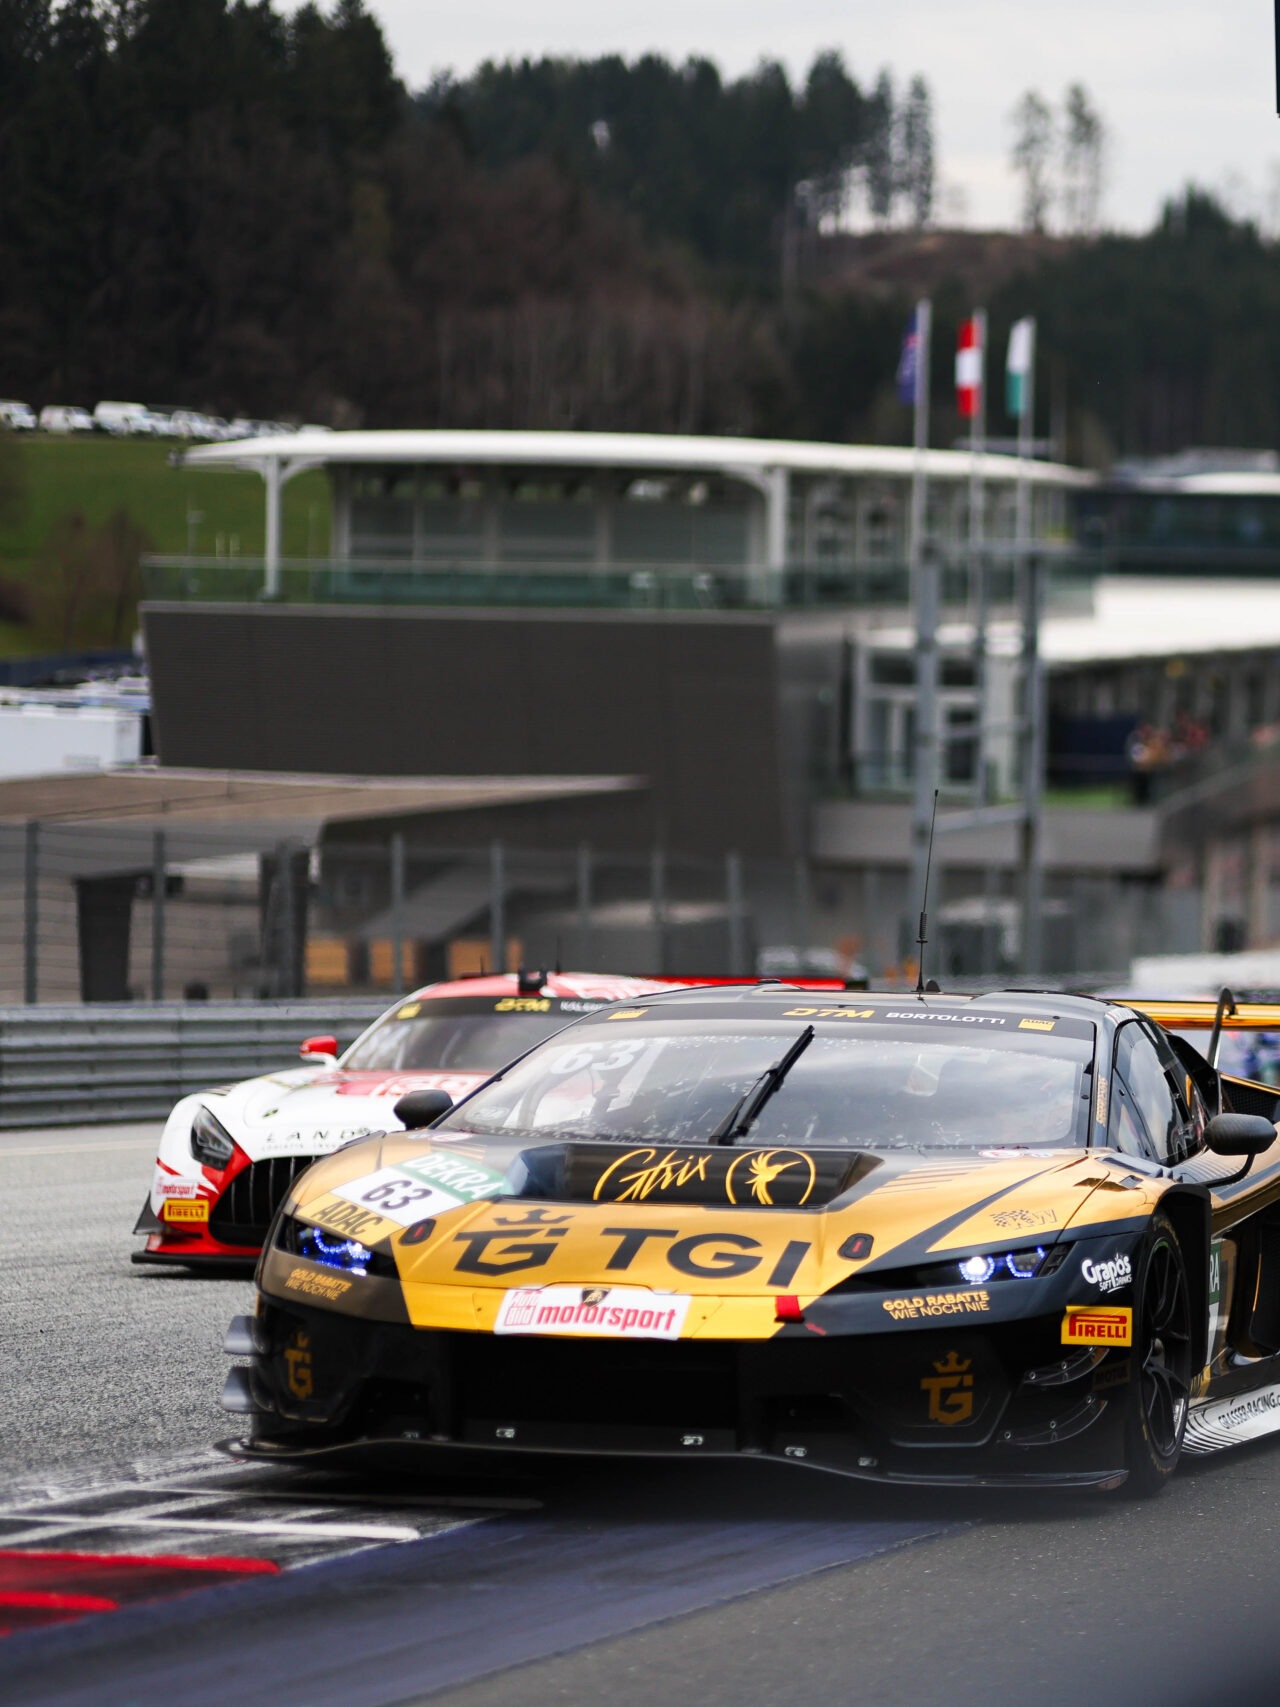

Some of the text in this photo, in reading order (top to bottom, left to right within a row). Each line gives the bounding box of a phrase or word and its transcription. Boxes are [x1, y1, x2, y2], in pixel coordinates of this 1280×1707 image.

[494, 998, 550, 1012] DTM
[781, 1007, 1006, 1025] DTM BORTOLOTTI
[549, 1038, 646, 1075] 63
[402, 1153, 505, 1199] DEKRA
[360, 1179, 433, 1211] 63
[167, 1204, 205, 1218] PIRELLI
[310, 1199, 384, 1236] ADAC
[599, 1227, 813, 1289] TGI
[882, 1290, 990, 1312] GOLD RABATTE
[889, 1300, 991, 1321] WIE NOCH NIE
[536, 1303, 677, 1332] motorsport
[1068, 1313, 1128, 1339] PIRELLI
